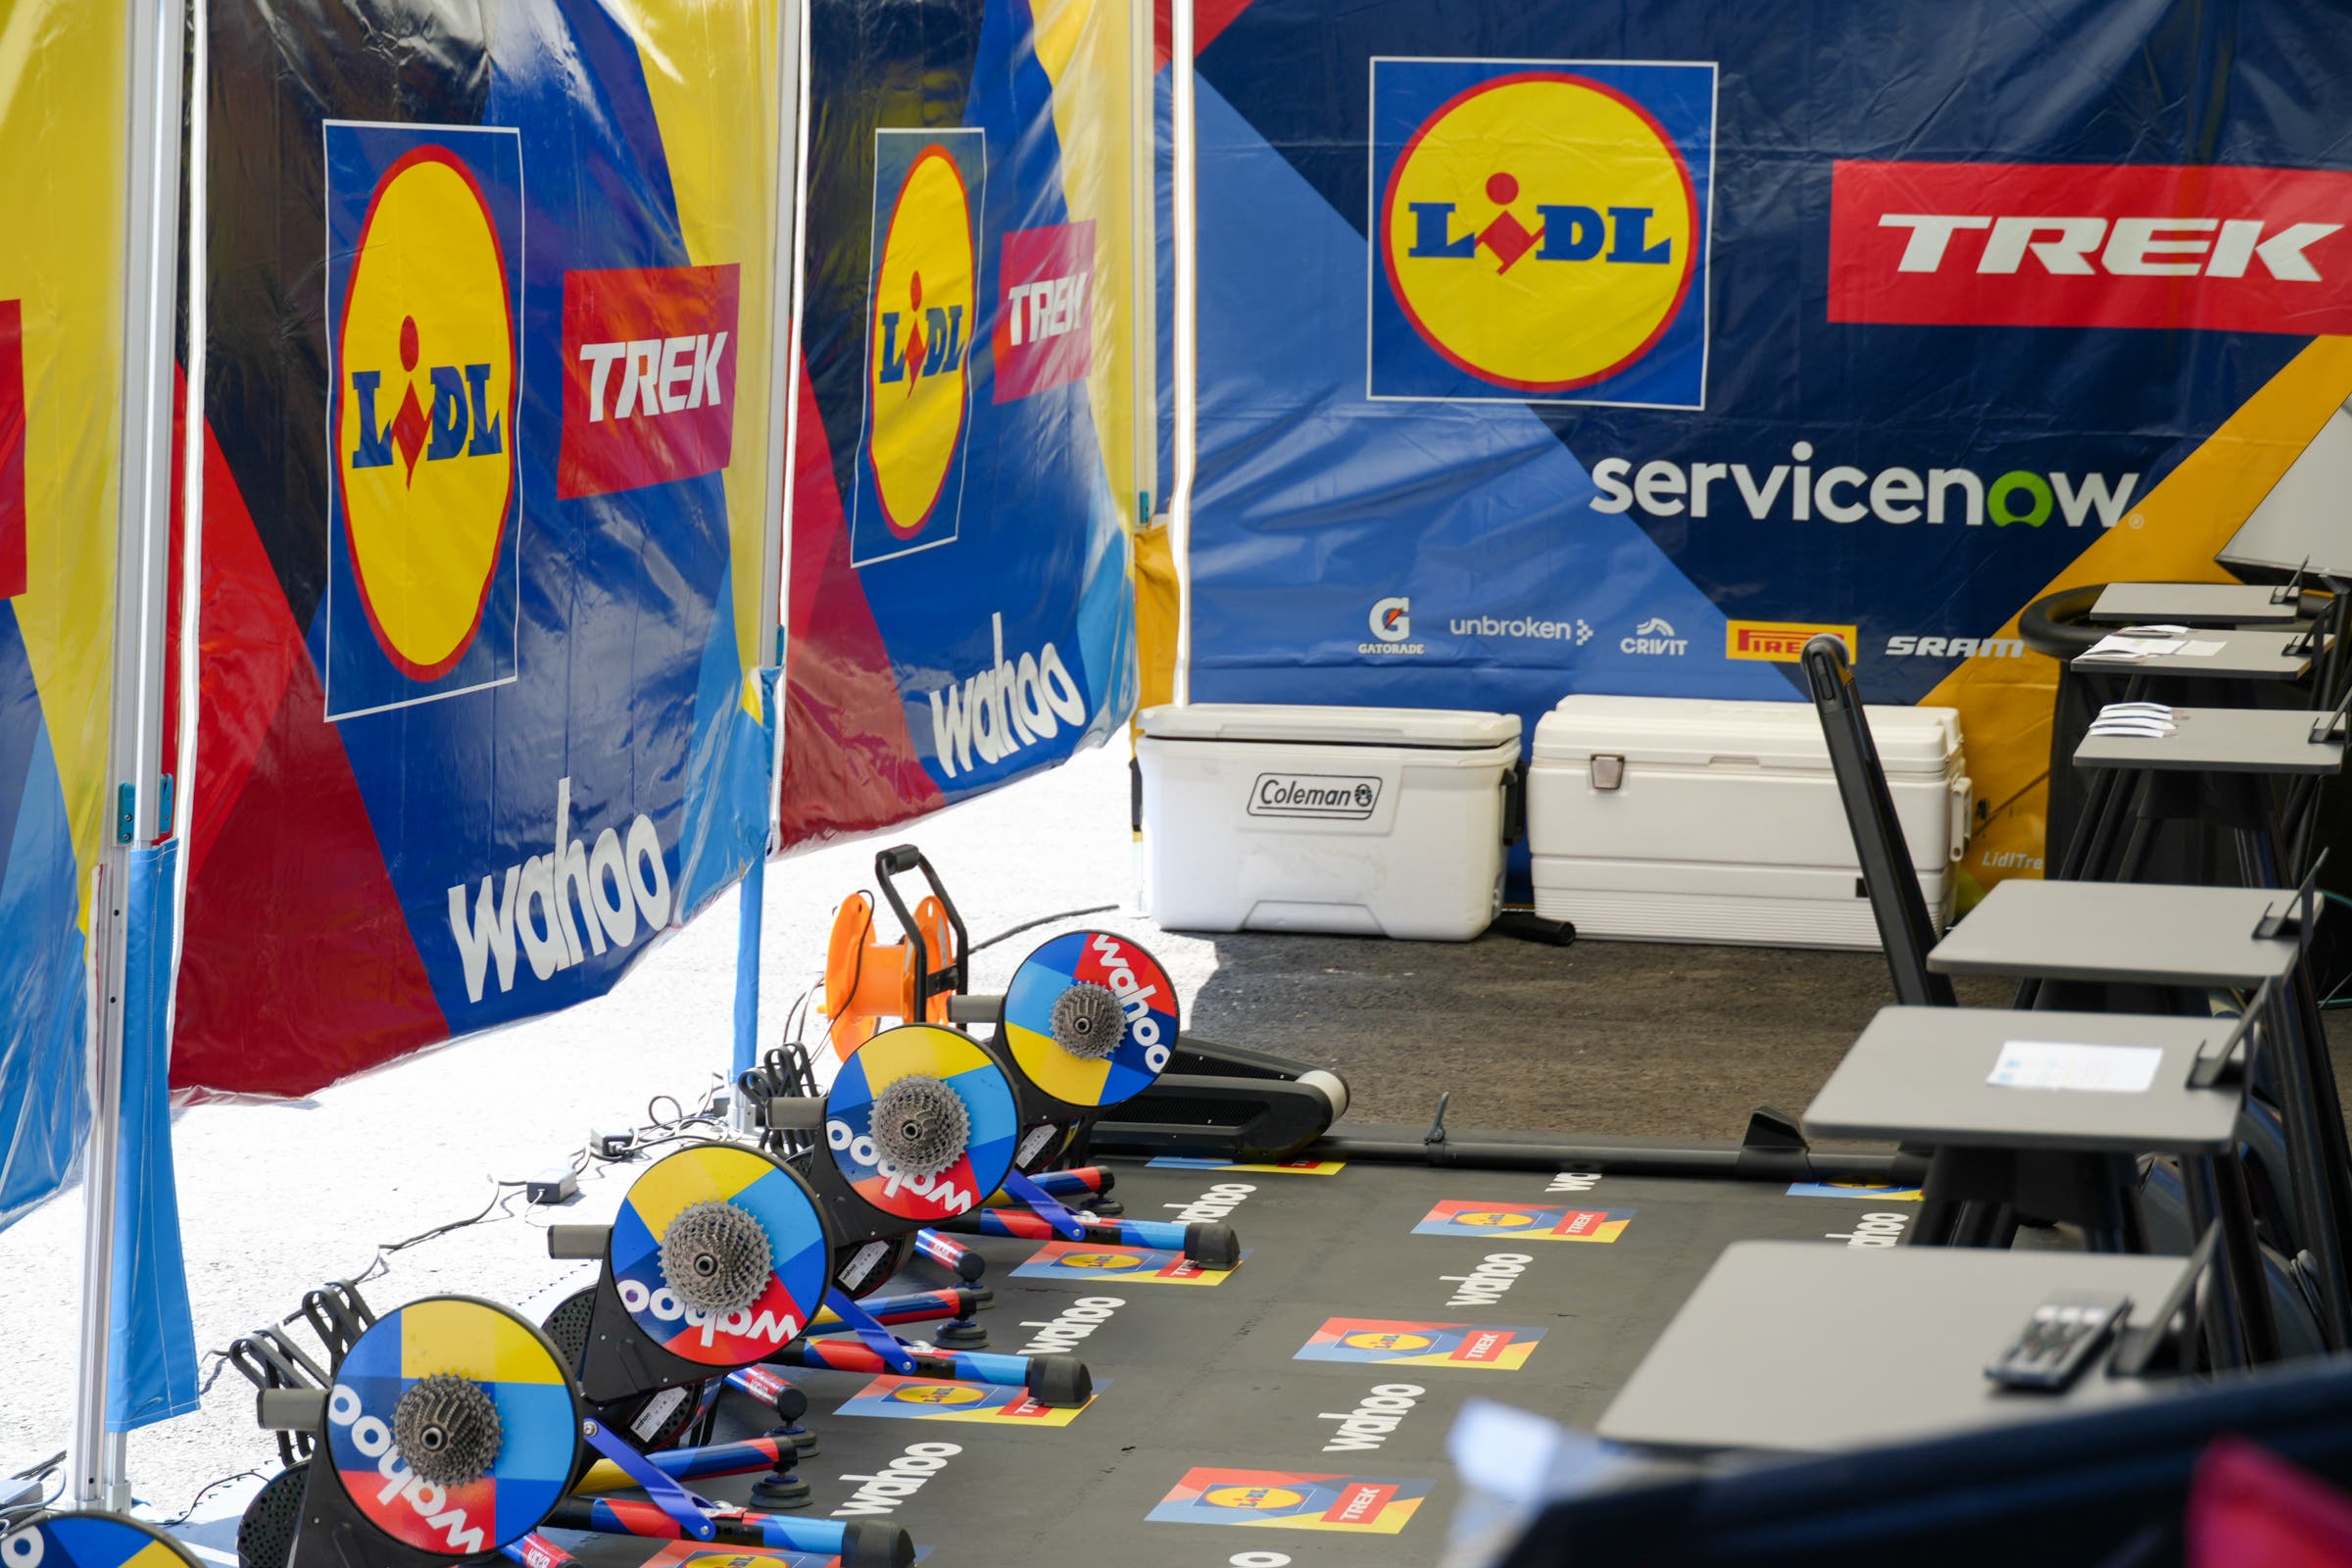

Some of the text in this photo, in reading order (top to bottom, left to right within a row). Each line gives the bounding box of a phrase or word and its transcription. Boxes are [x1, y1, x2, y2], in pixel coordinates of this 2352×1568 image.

[1878, 214, 2345, 282] TREK
[1008, 271, 1088, 346] TREK
[578, 331, 729, 422] TREK
[1589, 441, 2139, 527] servicenow
[1357, 642, 1425, 655] GATORADE
[1450, 615, 1571, 640] unbroken
[1620, 637, 1689, 656] CRIVIT
[1885, 636, 2026, 658] SRAM
[929, 612, 1086, 778] wahoo
[1260, 779, 1351, 807] Coleman
[448, 777, 670, 1003] wahoo
[1092, 934, 1170, 1073] wahoo
[1440, 1253, 1534, 1306] wahoo
[1016, 1297, 1126, 1354] wahoo
[1465, 1333, 1499, 1359] TREK
[1317, 1384, 1426, 1451] wahoo
[328, 1384, 484, 1554] wahoo
[830, 1443, 963, 1516] wahoo
[1339, 1487, 1380, 1520] TREK
